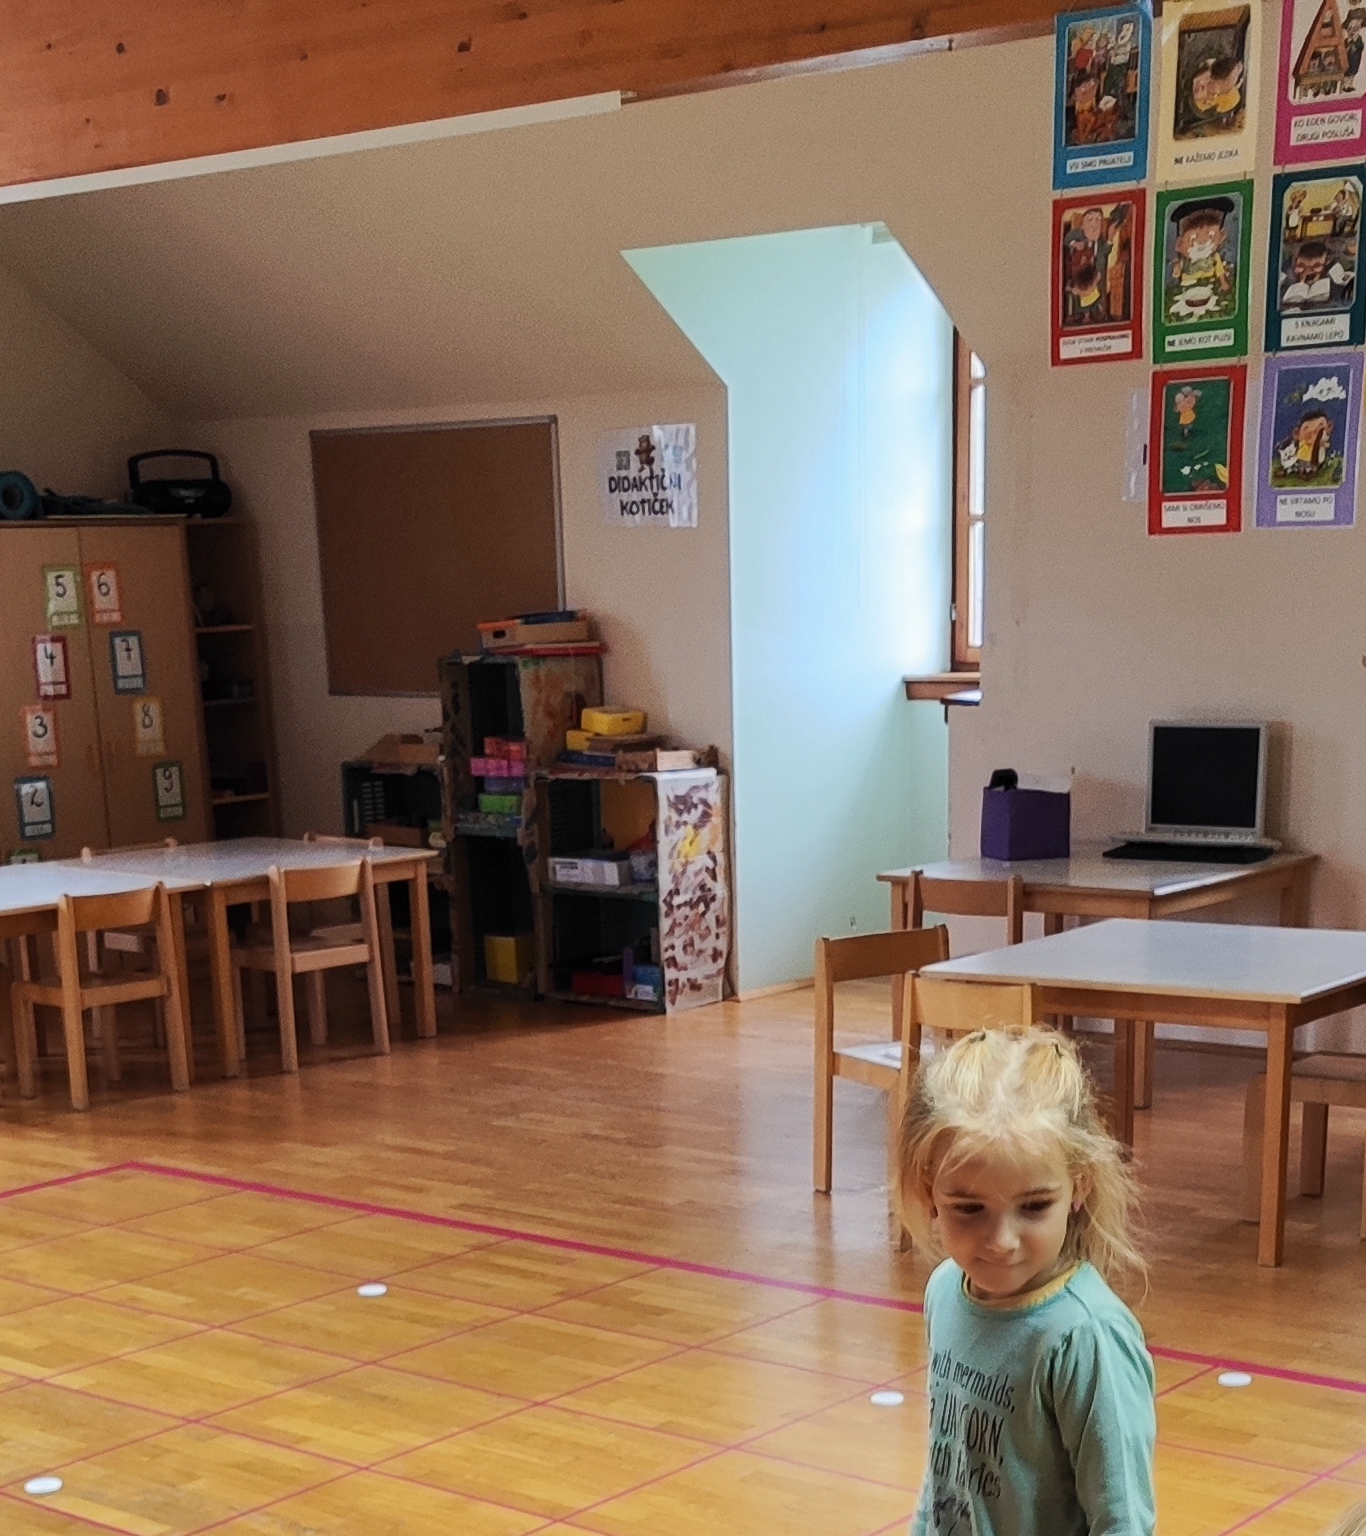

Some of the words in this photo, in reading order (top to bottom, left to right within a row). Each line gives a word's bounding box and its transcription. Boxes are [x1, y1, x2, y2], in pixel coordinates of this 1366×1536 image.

[1321, 124, 1355, 139] POSLUŠA
[619, 492, 674, 517] KOTIČEK
[54, 575, 67, 598] 5
[96, 572, 111, 597] 6
[43, 645, 56, 668] 4
[120, 637, 133, 662] 7
[31, 715, 48, 739] 3
[140, 703, 154, 729] 8
[163, 768, 174, 793] 9
[30, 783, 45, 807] 2
[953, 1361, 1016, 1414] mermaids,
[940, 1390, 1005, 1467] UNCORN,
